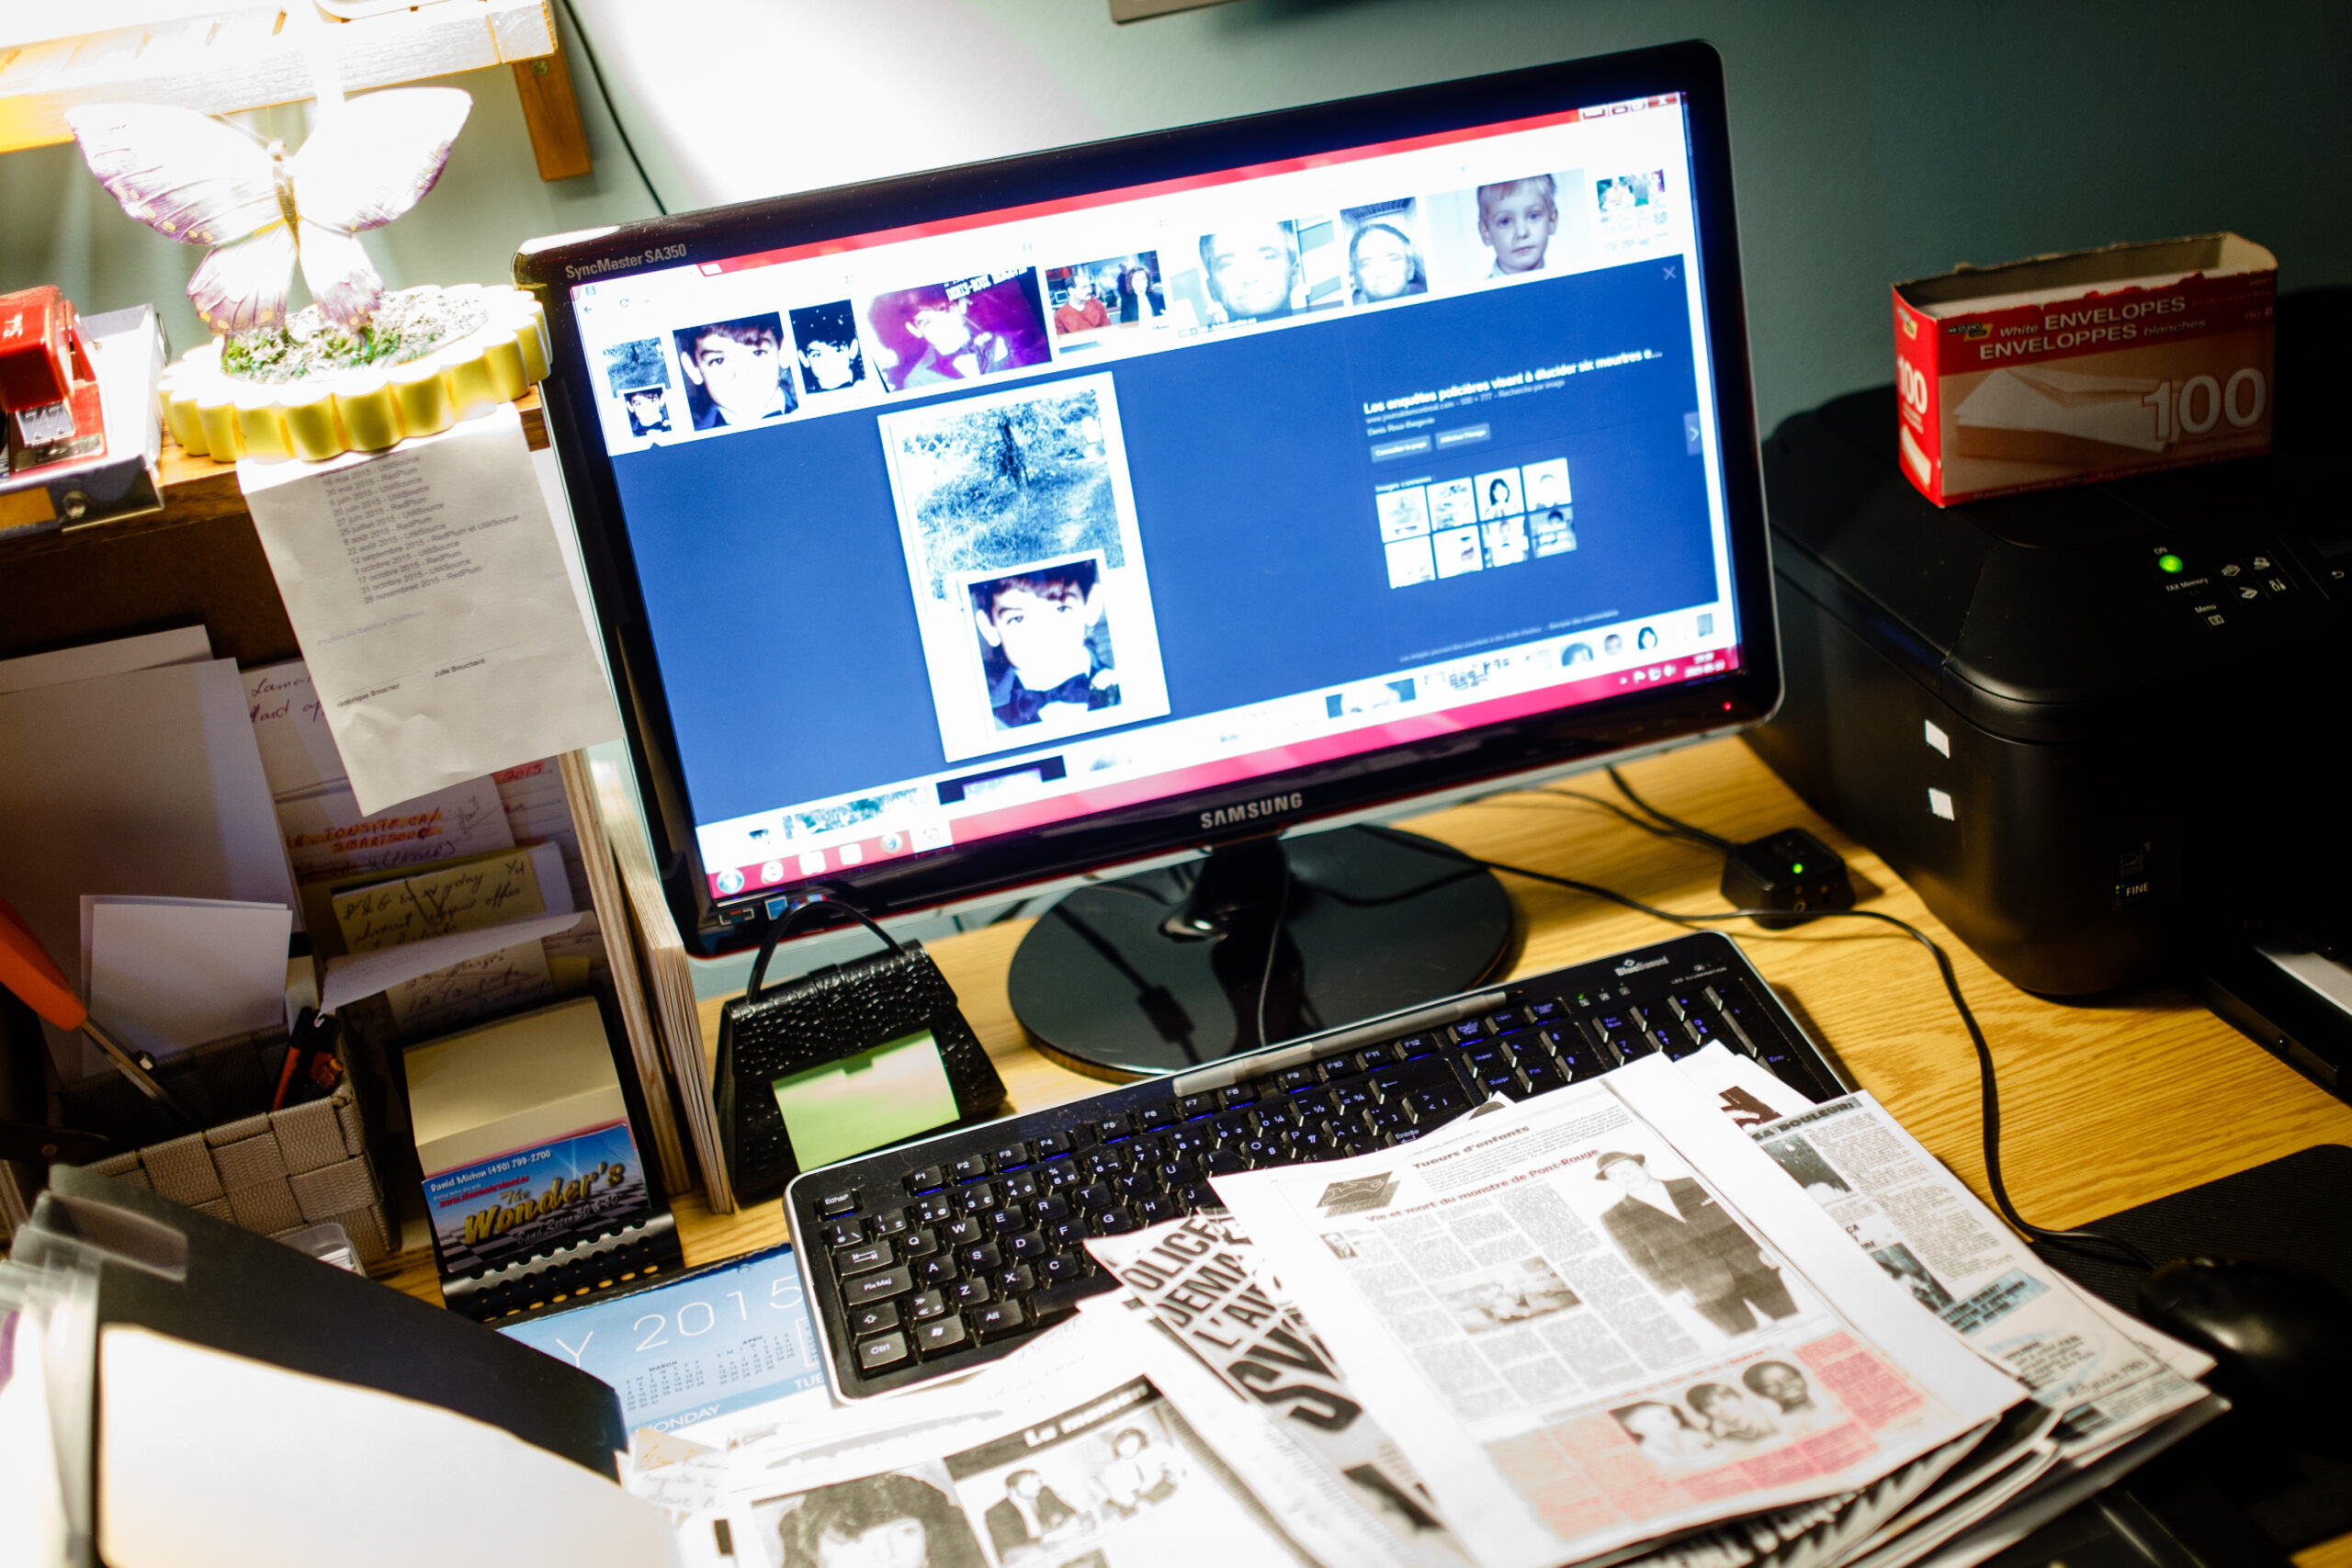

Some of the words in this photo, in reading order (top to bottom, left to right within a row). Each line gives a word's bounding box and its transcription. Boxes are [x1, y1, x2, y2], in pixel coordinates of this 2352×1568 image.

[565, 254, 643, 281] SyncMaster
[644, 243, 687, 265] SA350
[1999, 323, 2041, 338] White
[2044, 296, 2187, 332] ENVELOPES
[1979, 323, 2139, 361] ENVELOPPES
[2143, 319, 2207, 338] blanches
[1363, 401, 1385, 414] Les
[1386, 391, 1437, 409] enquêtes
[1438, 381, 1490, 401] policières
[1490, 371, 1523, 389] visant
[1524, 369, 1533, 383] à
[1534, 362, 1577, 381] élucider
[1578, 359, 1595, 373] six
[1595, 350, 1643, 369] meurtres
[1898, 355, 1928, 415] 100
[2142, 367, 2267, 441] 100
[24, 405, 61, 431] 747
[352, 468, 371, 479] 2015
[355, 478, 375, 490] 2015
[354, 489, 373, 501] 2015
[361, 498, 381, 509] 2015
[365, 507, 384, 519] 2015
[376, 515, 396, 526] 2015
[370, 528, 390, 538] 2015
[378, 536, 398, 547] 2015
[405, 539, 424, 550] 2015
[360, 561, 390, 572] octobre
[392, 553, 412, 565] 2015
[368, 569, 398, 581] octobre
[401, 561, 420, 573] 2015
[372, 579, 401, 591] octobre
[403, 570, 423, 582] 2015
[421, 576, 440, 588] 2015
[434, 667, 450, 679] Julie
[1200, 792, 1303, 829] SAMSUNG
[1405, 1038, 1421, 1047] F12
[1365, 1050, 1380, 1059] F11
[1327, 1060, 1343, 1069] F10
[1287, 1071, 1299, 1080] F9
[1227, 1088, 1239, 1096] F8
[1185, 1099, 1198, 1108] F7
[1144, 1109, 1157, 1119] F6
[1102, 1121, 1115, 1131] F5
[1751, 1130, 1776, 1141] SA
[1777, 1101, 1856, 1132] DOULEUR!
[1292, 1131, 1300, 1140] P
[1040, 1138, 1053, 1147] F4
[1250, 1142, 1261, 1150] O
[1412, 1148, 1461, 1169] Tueurs
[1463, 1124, 1531, 1154] d'enfants
[999, 1149, 1012, 1159] F3
[488, 1161, 511, 1176] (450)
[956, 1161, 969, 1171] F2
[1165, 1165, 1176, 1174] U
[915, 1171, 926, 1181] F1
[1123, 1178, 1134, 1187] Y
[1365, 1213, 1387, 1223] Vie
[1389, 1209, 1403, 1218] et
[1405, 1201, 1438, 1213] mort
[1440, 1195, 1457, 1205] du
[1458, 1180, 1510, 1201] monstre
[1510, 1173, 1526, 1186] de
[1528, 1148, 1600, 1179] Pont-Rouge
[498, 1188, 530, 1205] The
[1081, 1190, 1091, 1199] T
[464, 1161, 626, 1247] Wonder's
[1038, 1201, 1048, 1211] R
[1145, 1201, 1156, 1212] H
[995, 1213, 1005, 1223] E
[1103, 1214, 1114, 1224] G
[952, 1224, 966, 1235] W
[1059, 1226, 1068, 1235] F
[909, 1236, 919, 1247] Q
[1016, 1239, 1026, 1248] D
[972, 1251, 981, 1260] S
[1118, 1215, 1224, 1292] OLICE
[928, 1263, 939, 1273] A
[1049, 1261, 1060, 1270] C
[1005, 1273, 1016, 1283] X
[960, 1286, 970, 1295] Z
[633, 1273, 807, 1352] 2015
[986, 1311, 1001, 1322] Alt
[870, 1342, 890, 1356] Ctrl
[649, 1360, 678, 1372] MARCH
